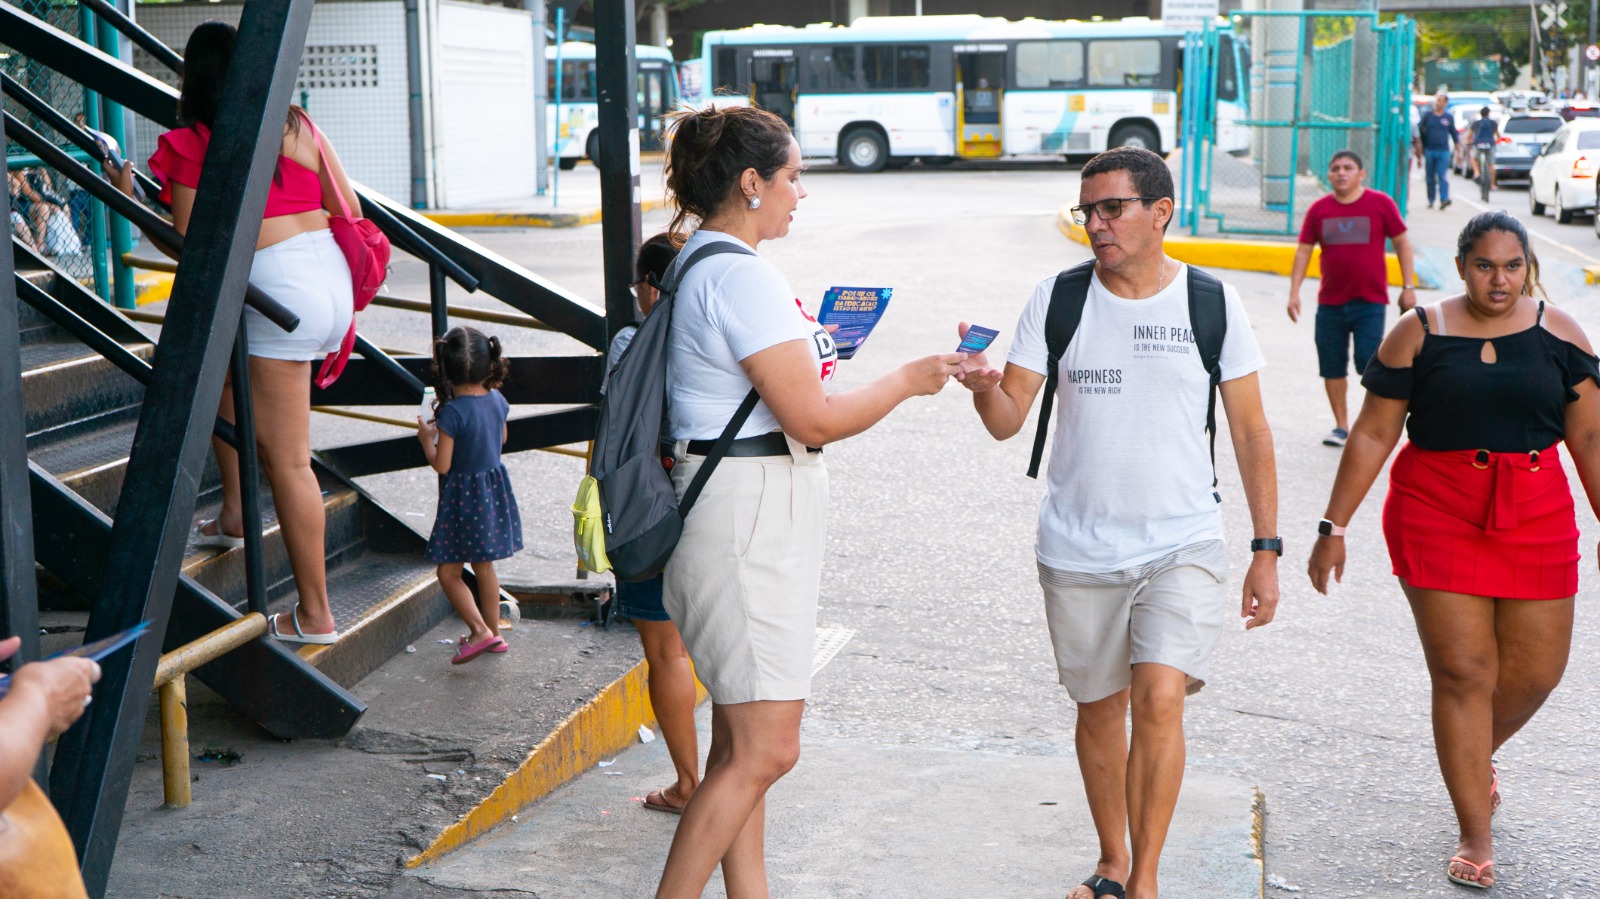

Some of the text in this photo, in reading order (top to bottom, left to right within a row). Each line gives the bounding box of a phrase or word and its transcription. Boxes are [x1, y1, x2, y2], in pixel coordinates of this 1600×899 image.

[1134, 325, 1195, 344] INNER PEAC
[1133, 343, 1140, 351] IS
[1141, 343, 1151, 351] THE
[1166, 345, 1190, 354] SUCCESS
[1067, 369, 1122, 384] HAPPINESS
[1078, 386, 1083, 394] IS
[1084, 386, 1093, 394] THE
